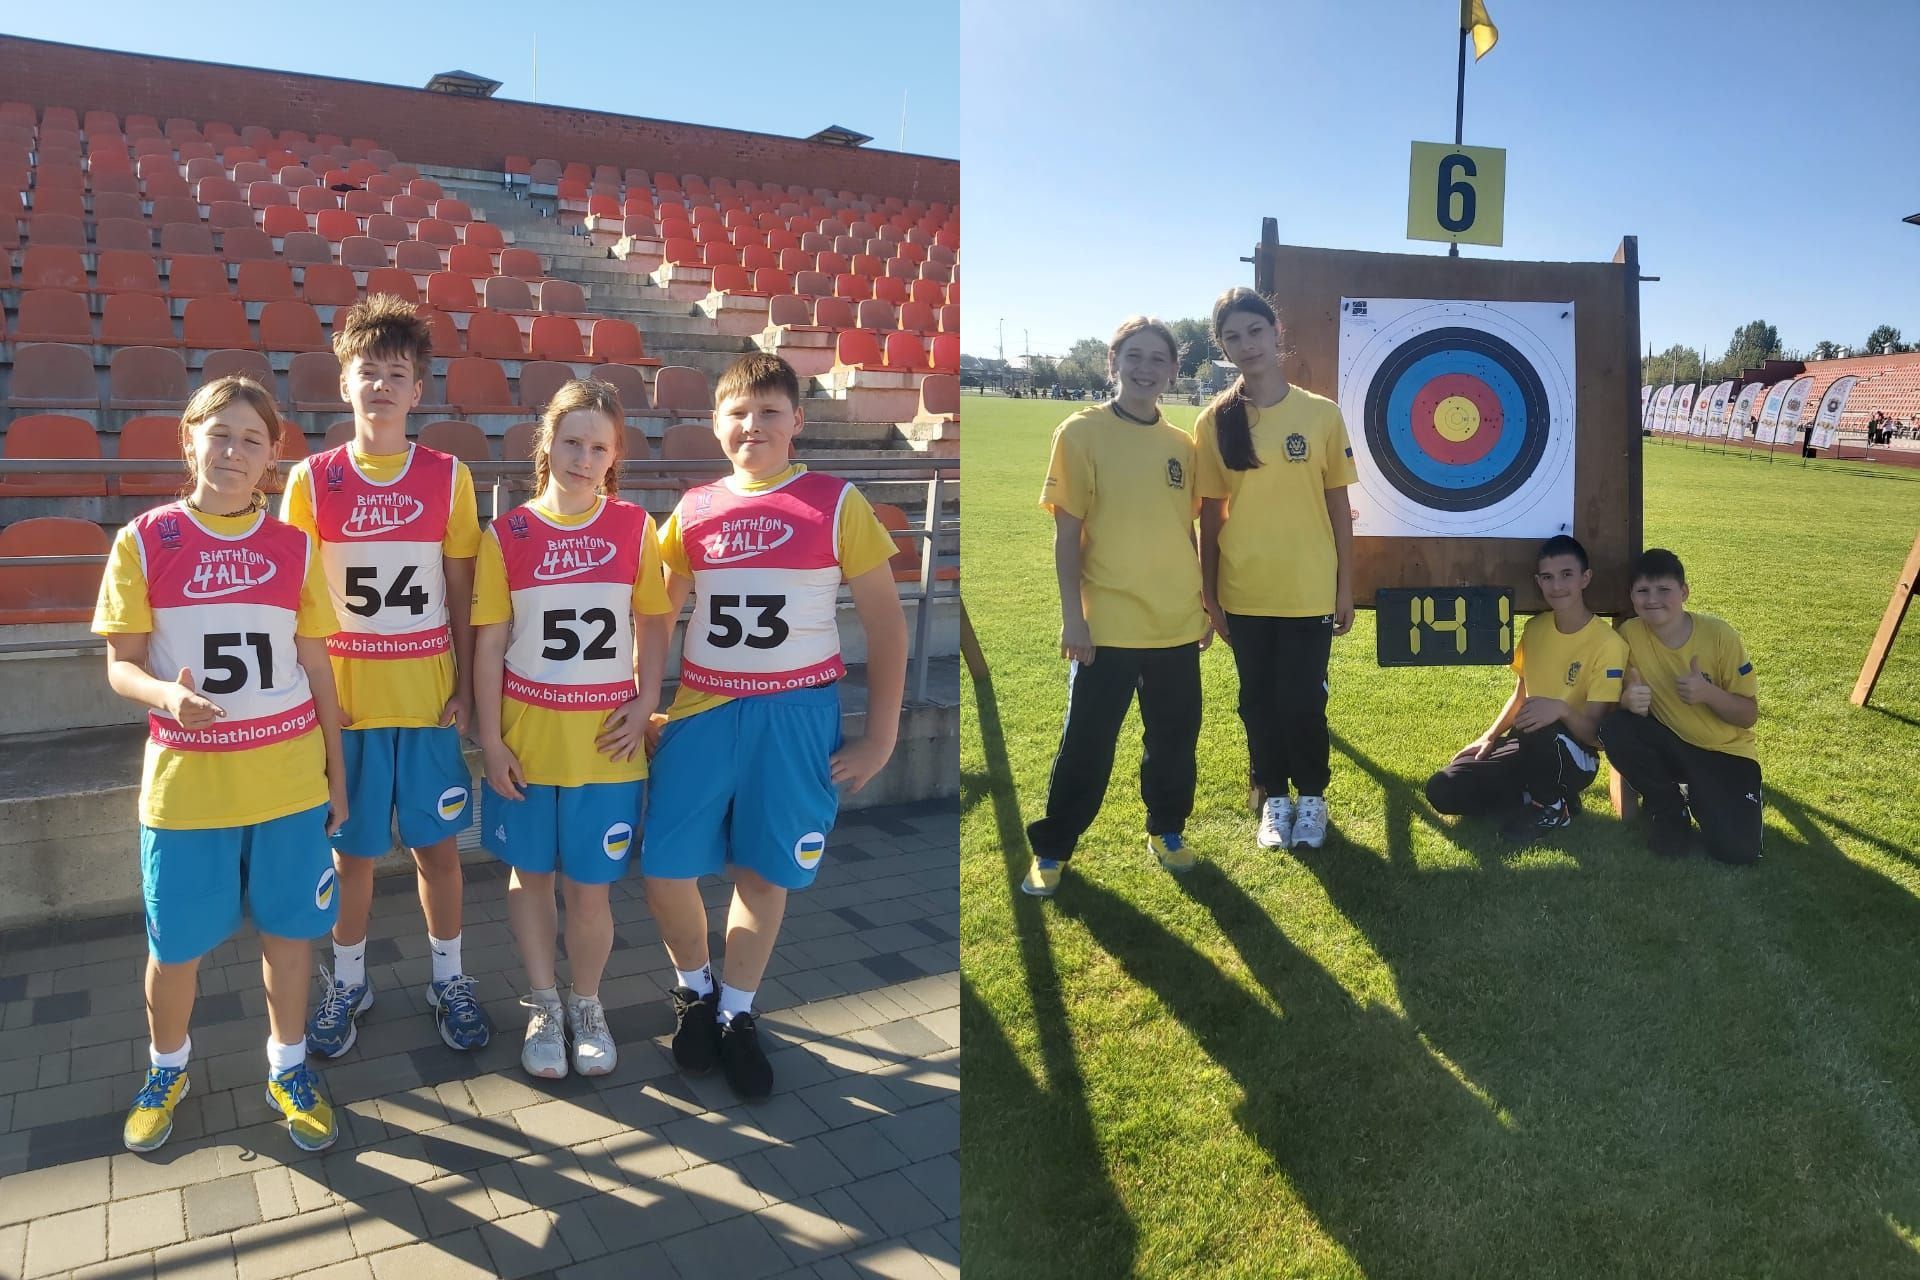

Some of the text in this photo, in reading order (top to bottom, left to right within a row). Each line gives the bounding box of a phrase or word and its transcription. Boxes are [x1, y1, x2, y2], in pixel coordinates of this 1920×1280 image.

[1436, 153, 1477, 233] 6
[345, 565, 429, 618] 54
[325, 634, 449, 653] ww.biathlon.org.u
[541, 607, 617, 661] 52
[706, 594, 790, 650] 53
[202, 632, 274, 695] 51
[507, 679, 636, 703] www.biathlon.org.u
